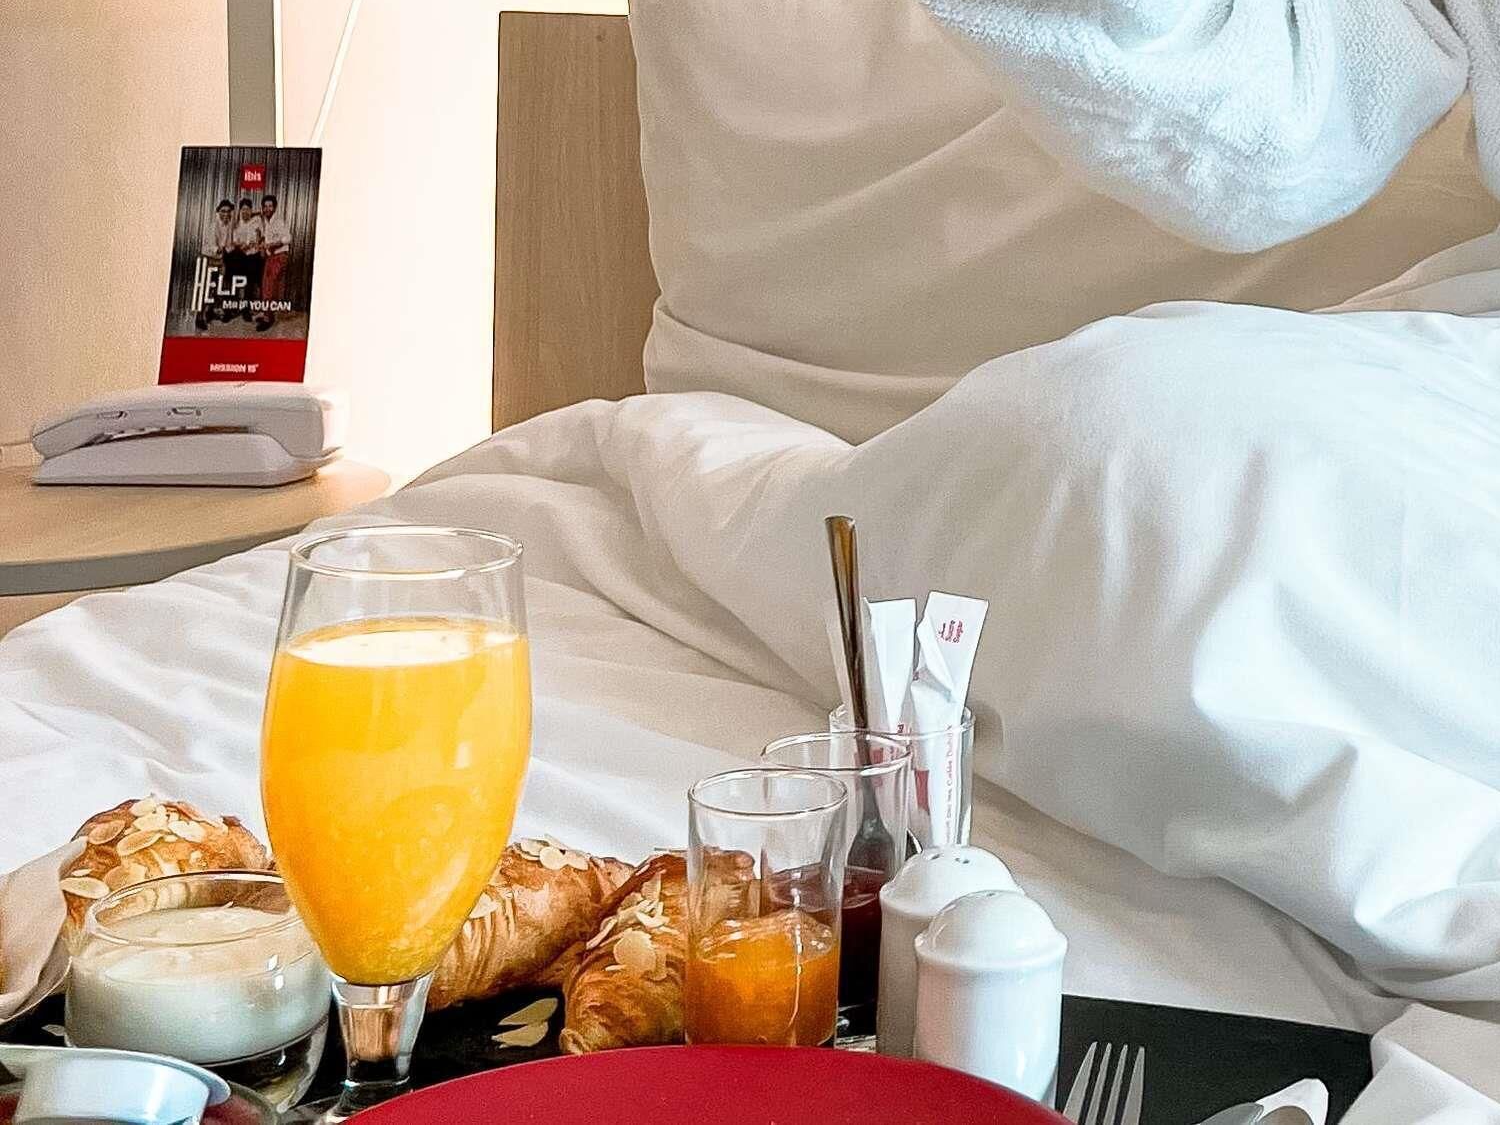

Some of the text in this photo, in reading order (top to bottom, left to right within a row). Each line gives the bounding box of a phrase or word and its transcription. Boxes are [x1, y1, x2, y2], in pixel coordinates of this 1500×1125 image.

[191, 256, 247, 312] HELP
[249, 300, 269, 311] YOU
[270, 301, 291, 311] CAN
